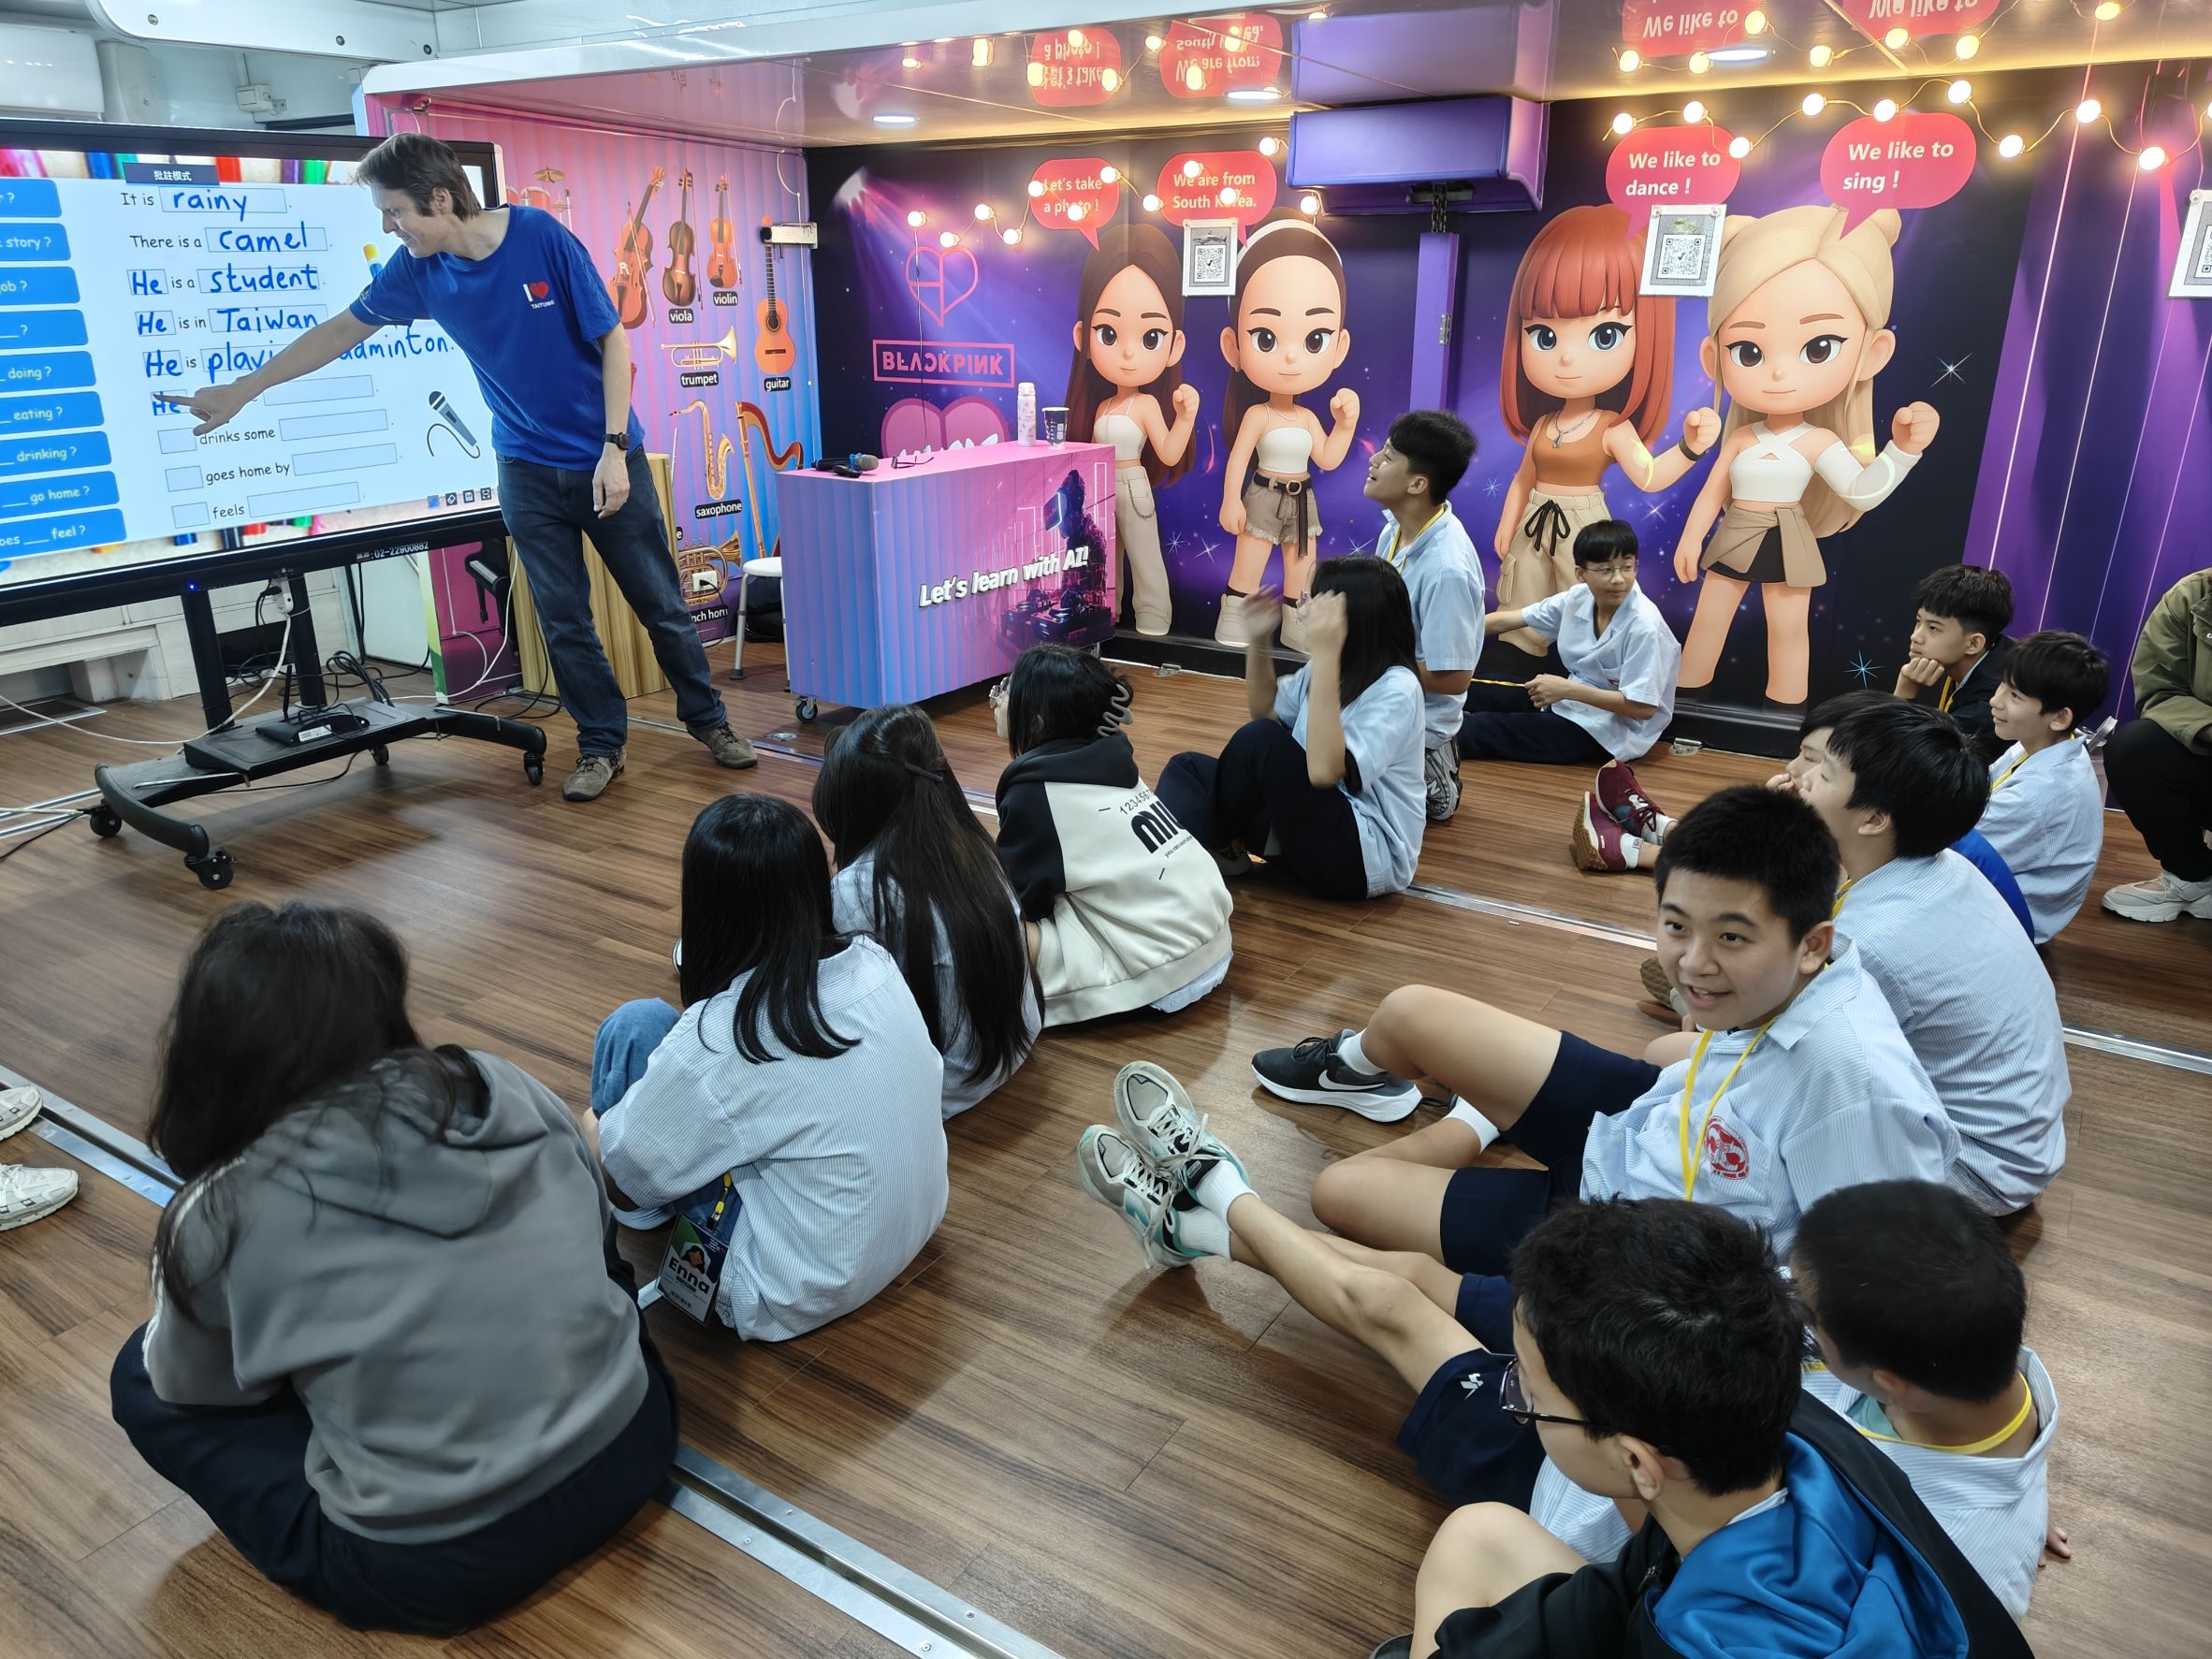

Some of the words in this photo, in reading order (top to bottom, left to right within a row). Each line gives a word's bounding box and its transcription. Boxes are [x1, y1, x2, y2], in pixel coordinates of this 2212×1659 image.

[1848, 143, 1881, 161] We
[1887, 140, 1925, 159] like
[1931, 141, 1954, 157] to
[1629, 153, 1657, 169] We
[1663, 151, 1695, 167] like
[1701, 152, 1721, 167] to
[1075, 176, 1102, 190] take
[1173, 174, 1195, 186] We
[1198, 176, 1218, 186] are
[1222, 171, 1255, 185] from
[1842, 171, 1885, 194] sing
[1625, 180, 1679, 196] dance
[121, 193, 137, 206] It
[143, 193, 154, 206] is
[173, 189, 247, 222] rainy
[1043, 202, 1051, 212] a
[1173, 195, 1210, 209] South
[7, 237, 40, 251] story
[129, 235, 174, 247] There
[178, 235, 190, 247] is
[194, 239, 202, 247] a
[132, 270, 163, 296] He
[171, 275, 182, 288] is
[187, 278, 196, 288] a
[210, 263, 317, 293] student
[714, 294, 737, 305] violin
[138, 312, 167, 335] He
[179, 315, 190, 328] is
[195, 316, 207, 327] in
[216, 307, 318, 333] Taiwan
[670, 311, 692, 322] viola
[145, 349, 182, 378] He
[186, 356, 197, 368] is
[8, 367, 42, 381] doing
[681, 374, 718, 386] trumpet
[765, 379, 790, 390] guitar
[14, 408, 53, 420] eating
[199, 430, 240, 445] drinks
[244, 429, 276, 442] some
[17, 448, 67, 462] drinking
[206, 469, 235, 485] goes
[240, 464, 272, 478] home
[276, 462, 290, 475] by
[30, 492, 45, 504] go
[48, 488, 80, 501] home
[212, 505, 245, 518] feels
[695, 502, 742, 517] saxophone
[51, 526, 77, 539] feel
[919, 576, 968, 607] Let's
[970, 567, 1018, 594] learn
[1022, 553, 1060, 581] with
[669, 1257, 710, 1295] Enna
